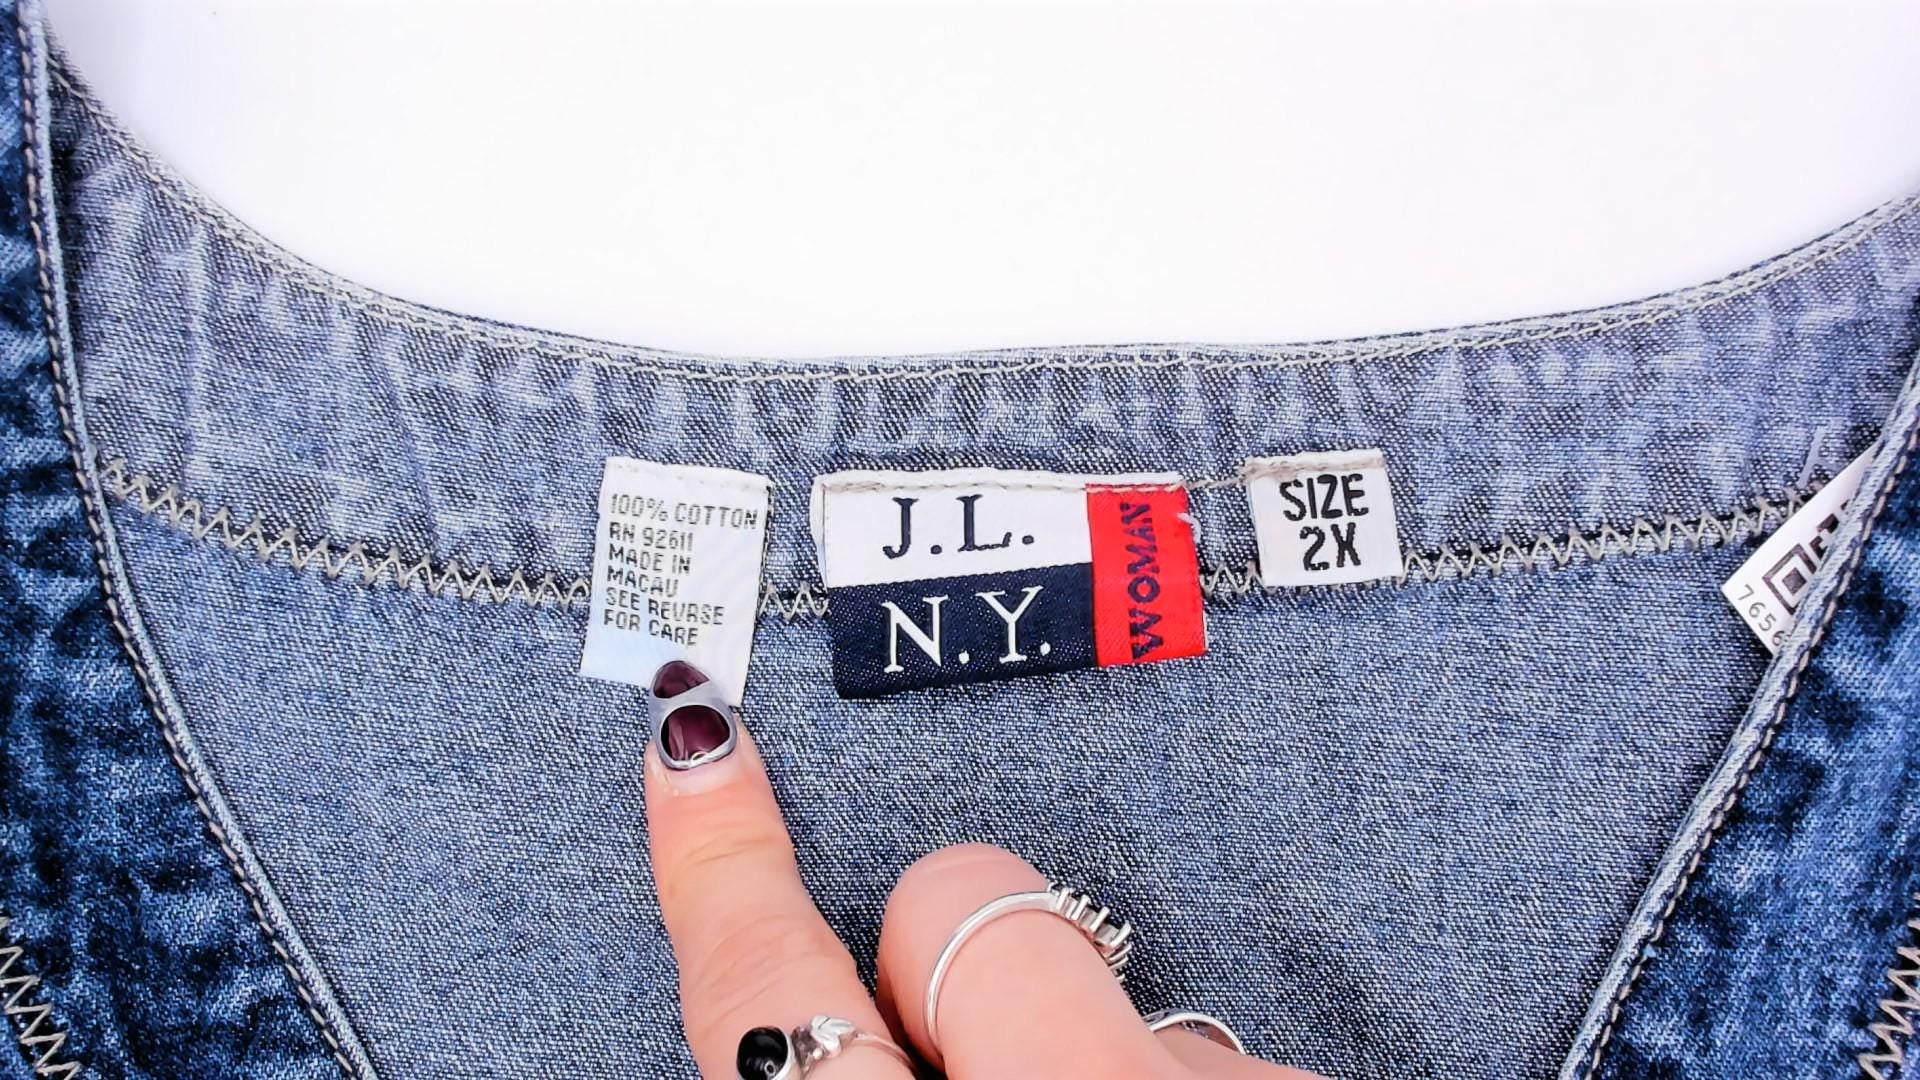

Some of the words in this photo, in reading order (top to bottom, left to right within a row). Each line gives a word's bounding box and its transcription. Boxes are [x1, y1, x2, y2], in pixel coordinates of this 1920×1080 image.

[610, 493, 669, 522] 100%
[673, 502, 758, 530] COTTON
[1279, 473, 1369, 522] SIZE
[609, 521, 636, 543] RN
[641, 527, 693, 552] 92611
[882, 494, 1035, 559] J.L.
[608, 543, 664, 572] MADE
[671, 554, 692, 575] IN
[1299, 522, 1362, 571] 2X
[605, 587, 640, 611] SEE
[606, 565, 679, 598] MACAU
[1120, 502, 1164, 660] WOMAN
[603, 608, 640, 632] FOR
[648, 619, 699, 646] CARE
[880, 585, 1051, 673] N.Y.
